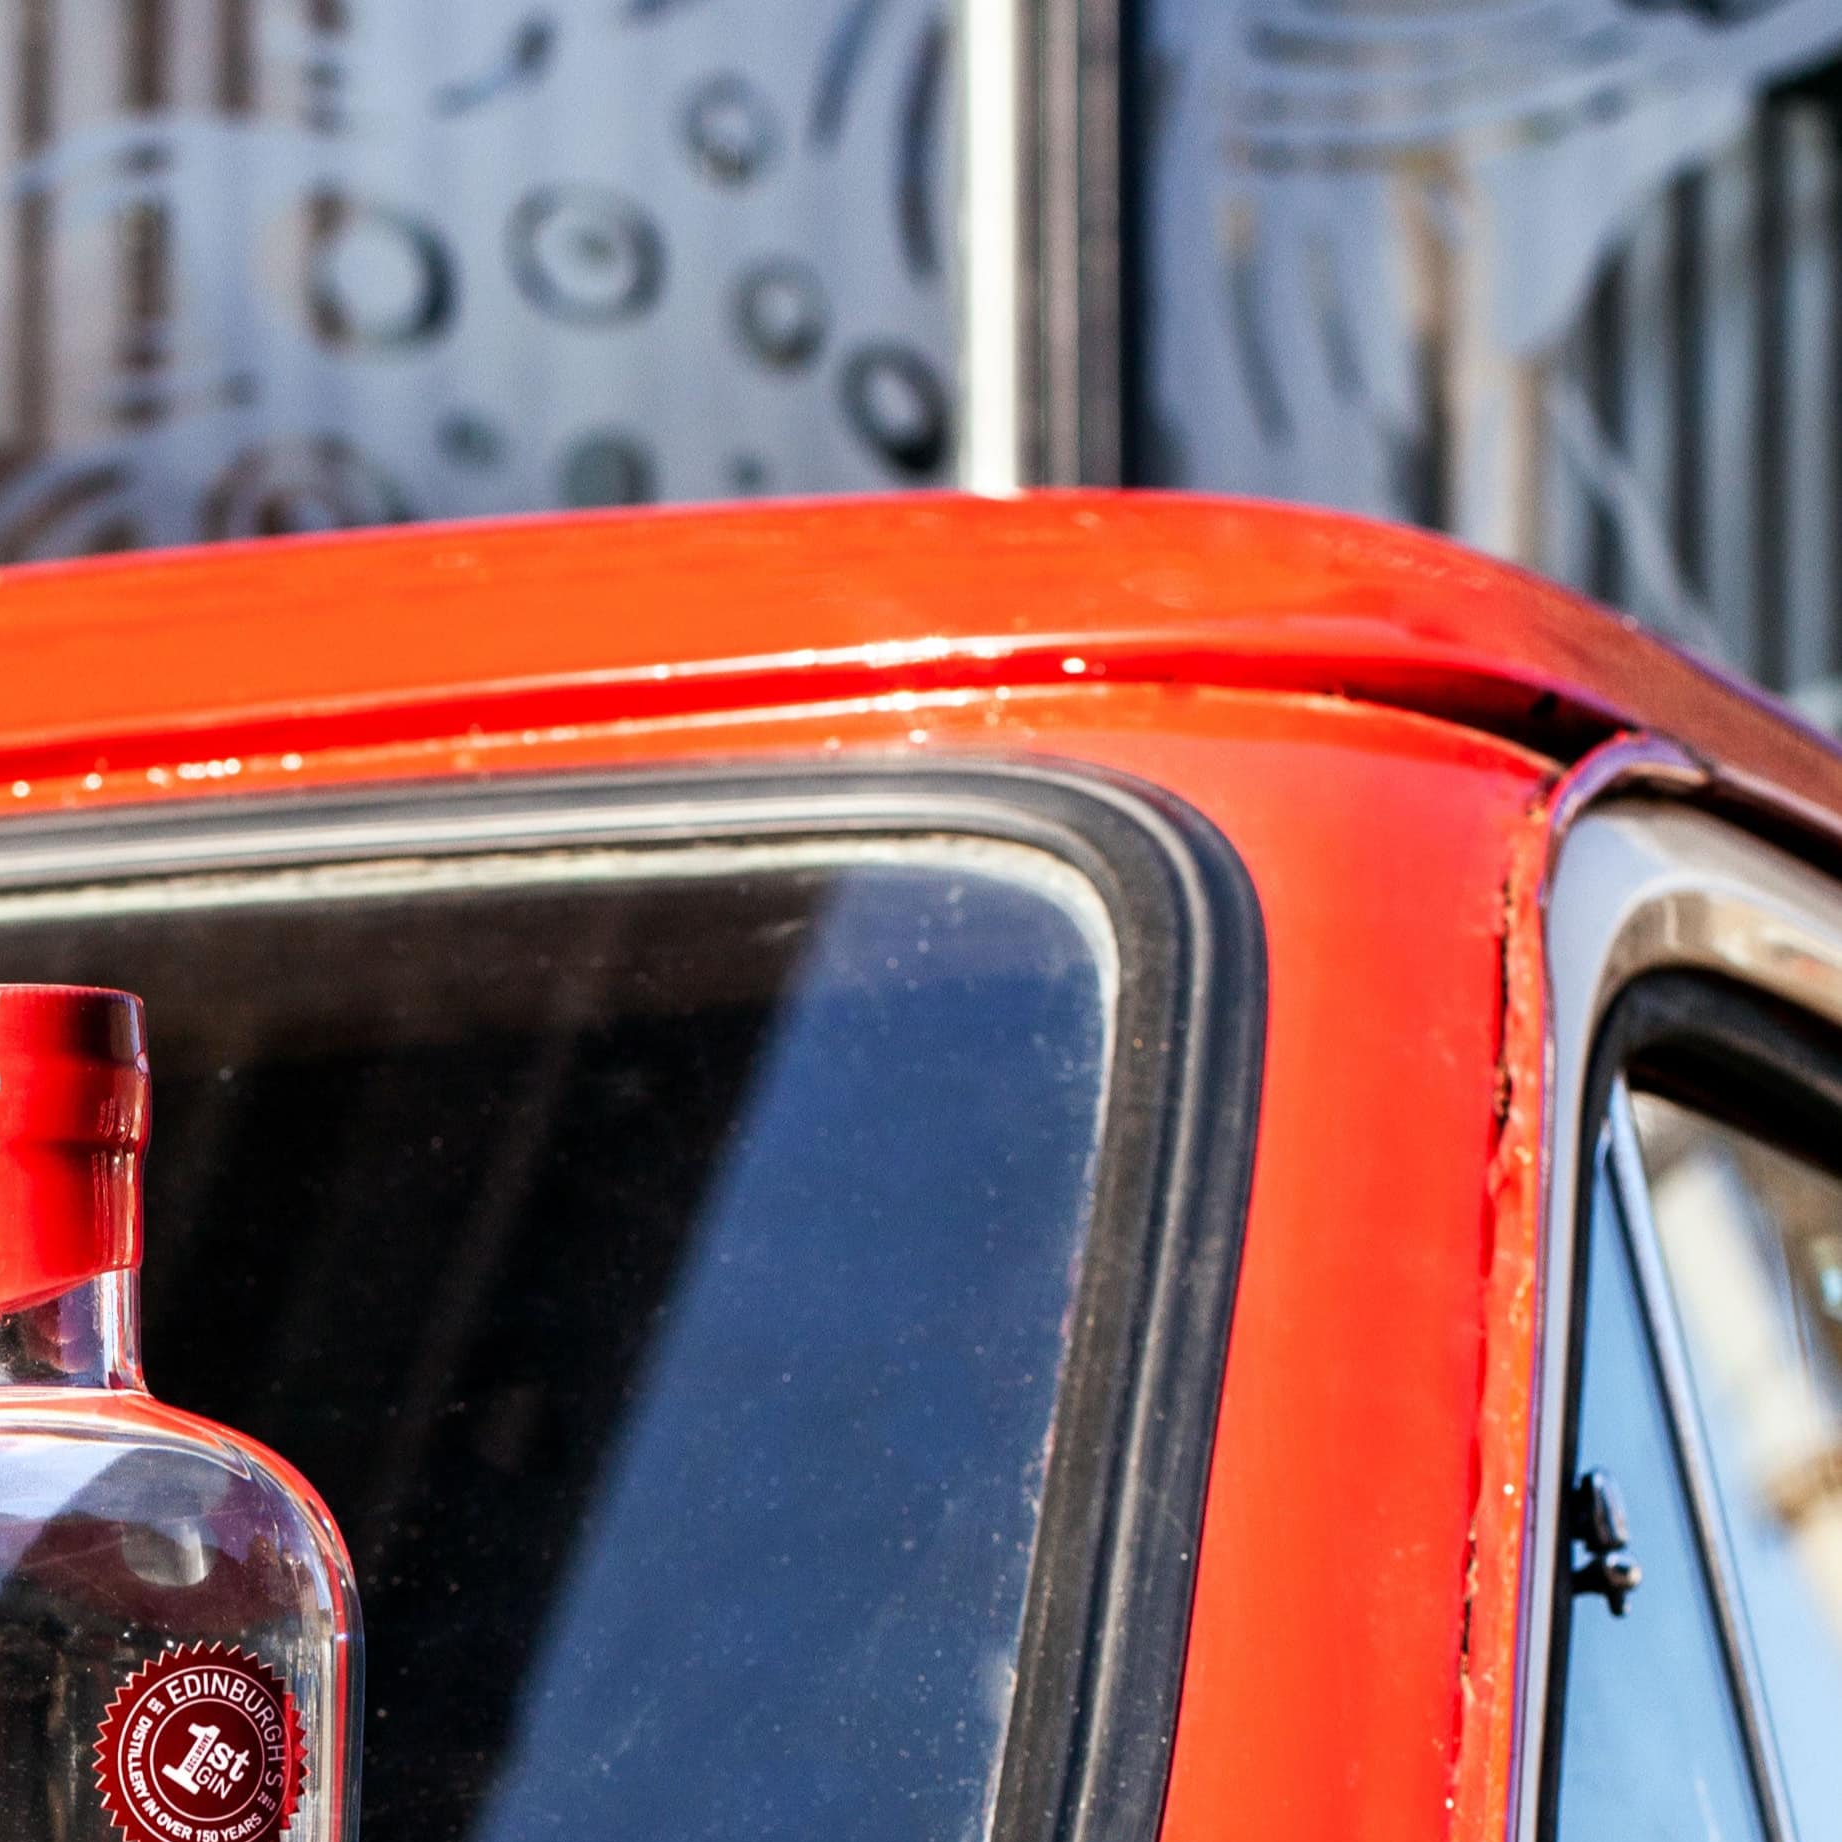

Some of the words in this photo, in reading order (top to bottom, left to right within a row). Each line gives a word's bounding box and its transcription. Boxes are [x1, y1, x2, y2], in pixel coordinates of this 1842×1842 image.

[161, 1722, 250, 1795] 1st
[166, 1672, 286, 1787] EDINBURGH'S
[127, 1715, 153, 1799] DISTILLERY
[141, 1798, 161, 1817] IN
[156, 1812, 193, 1841] OVER
[220, 1812, 263, 1842] YEARS
[196, 1766, 233, 1799] GIN
